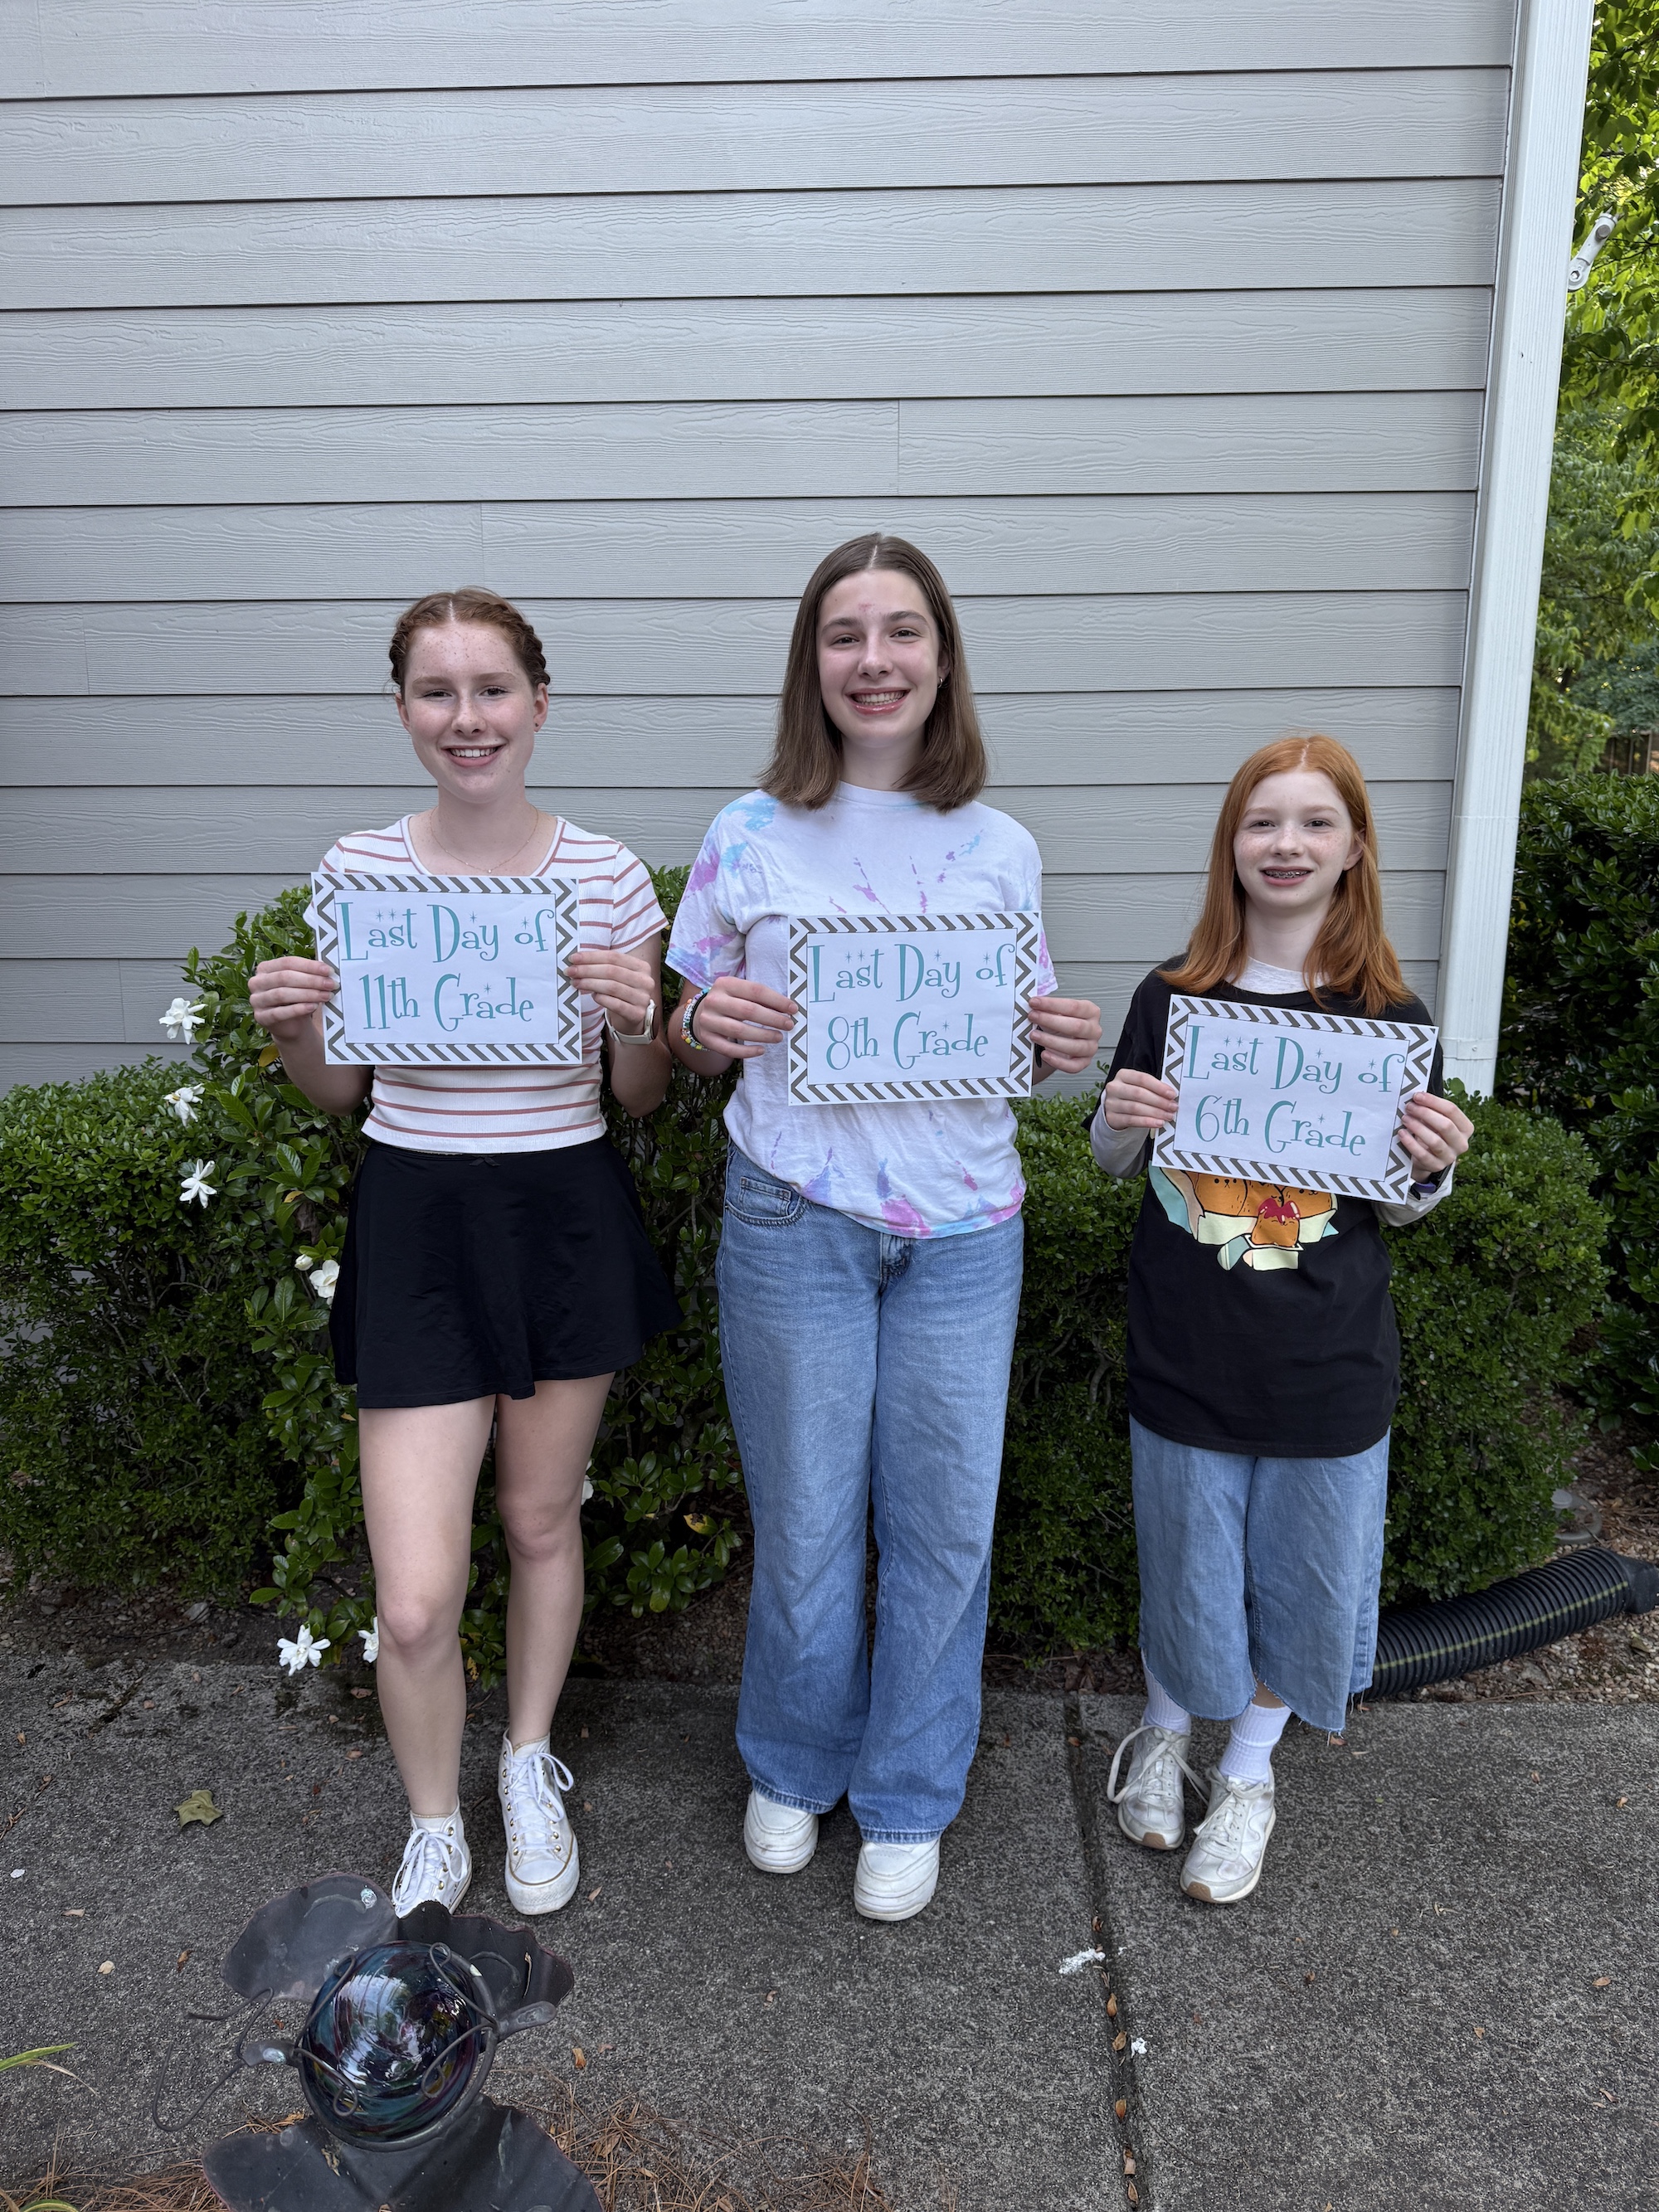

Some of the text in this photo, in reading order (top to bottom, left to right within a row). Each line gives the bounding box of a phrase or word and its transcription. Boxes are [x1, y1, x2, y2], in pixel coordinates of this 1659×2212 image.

[335, 902, 555, 963] Last Day of
[358, 973, 534, 1032] 11th Grade
[807, 943, 1016, 1003] Last Day of
[825, 1011, 989, 1070] 8th Grade
[1183, 1025, 1405, 1095] Last Day of
[1195, 1095, 1366, 1156] 6th Grade
